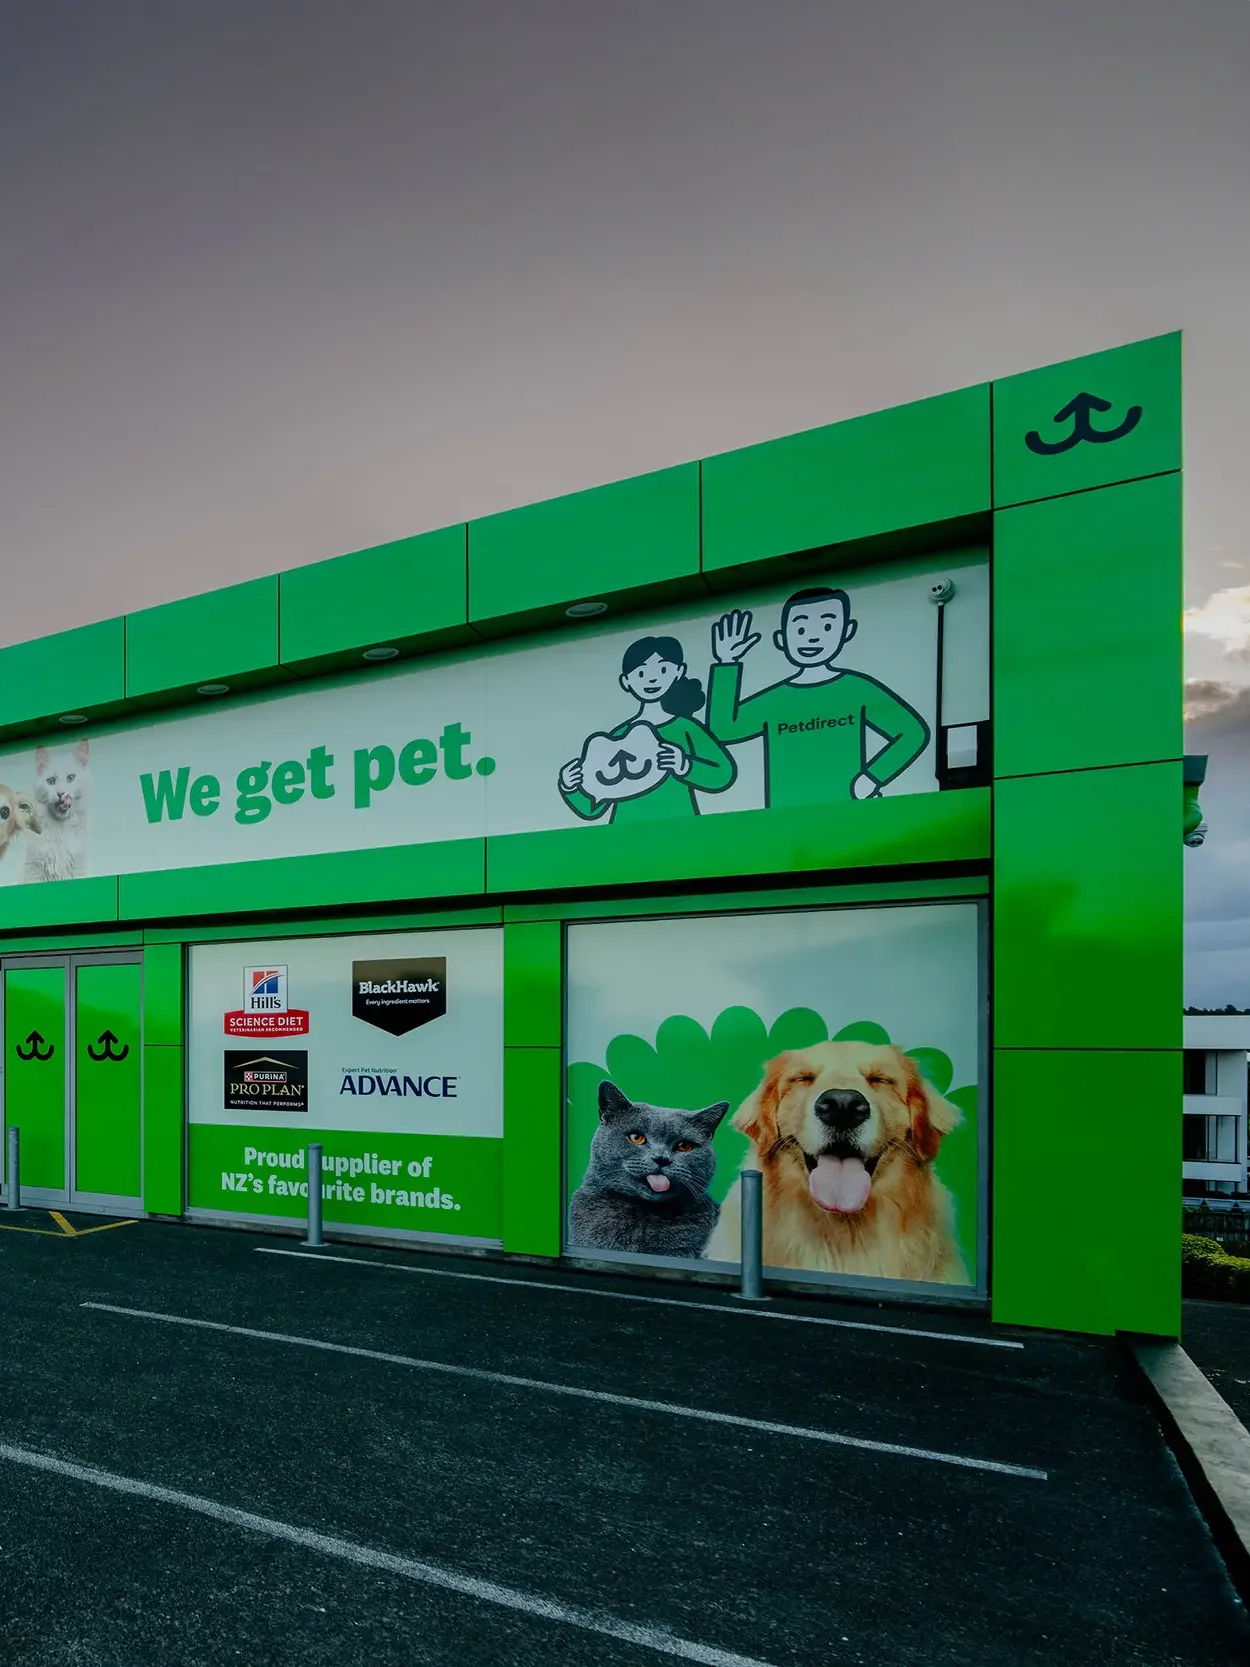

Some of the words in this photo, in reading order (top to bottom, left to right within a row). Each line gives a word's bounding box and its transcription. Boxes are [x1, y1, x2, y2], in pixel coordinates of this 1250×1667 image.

[777, 713, 855, 736] Petdirect
[139, 766, 220, 824] We
[234, 745, 336, 825] get
[354, 722, 496, 809] pet.
[358, 979, 438, 994] BlackHawk
[250, 996, 282, 1009] Hill's
[381, 998, 408, 1006] ingredient
[229, 1017, 275, 1027] SCIENCE
[277, 1016, 304, 1027] DIET
[253, 1073, 285, 1081] PURINA
[230, 1083, 260, 1095] PRO
[339, 1075, 458, 1098] ADVANCE
[244, 1147, 305, 1169] Proud
[321, 1152, 402, 1178] upplier
[407, 1156, 434, 1178] of
[221, 1172, 264, 1194] NZ's
[370, 1182, 462, 1211] brands.
